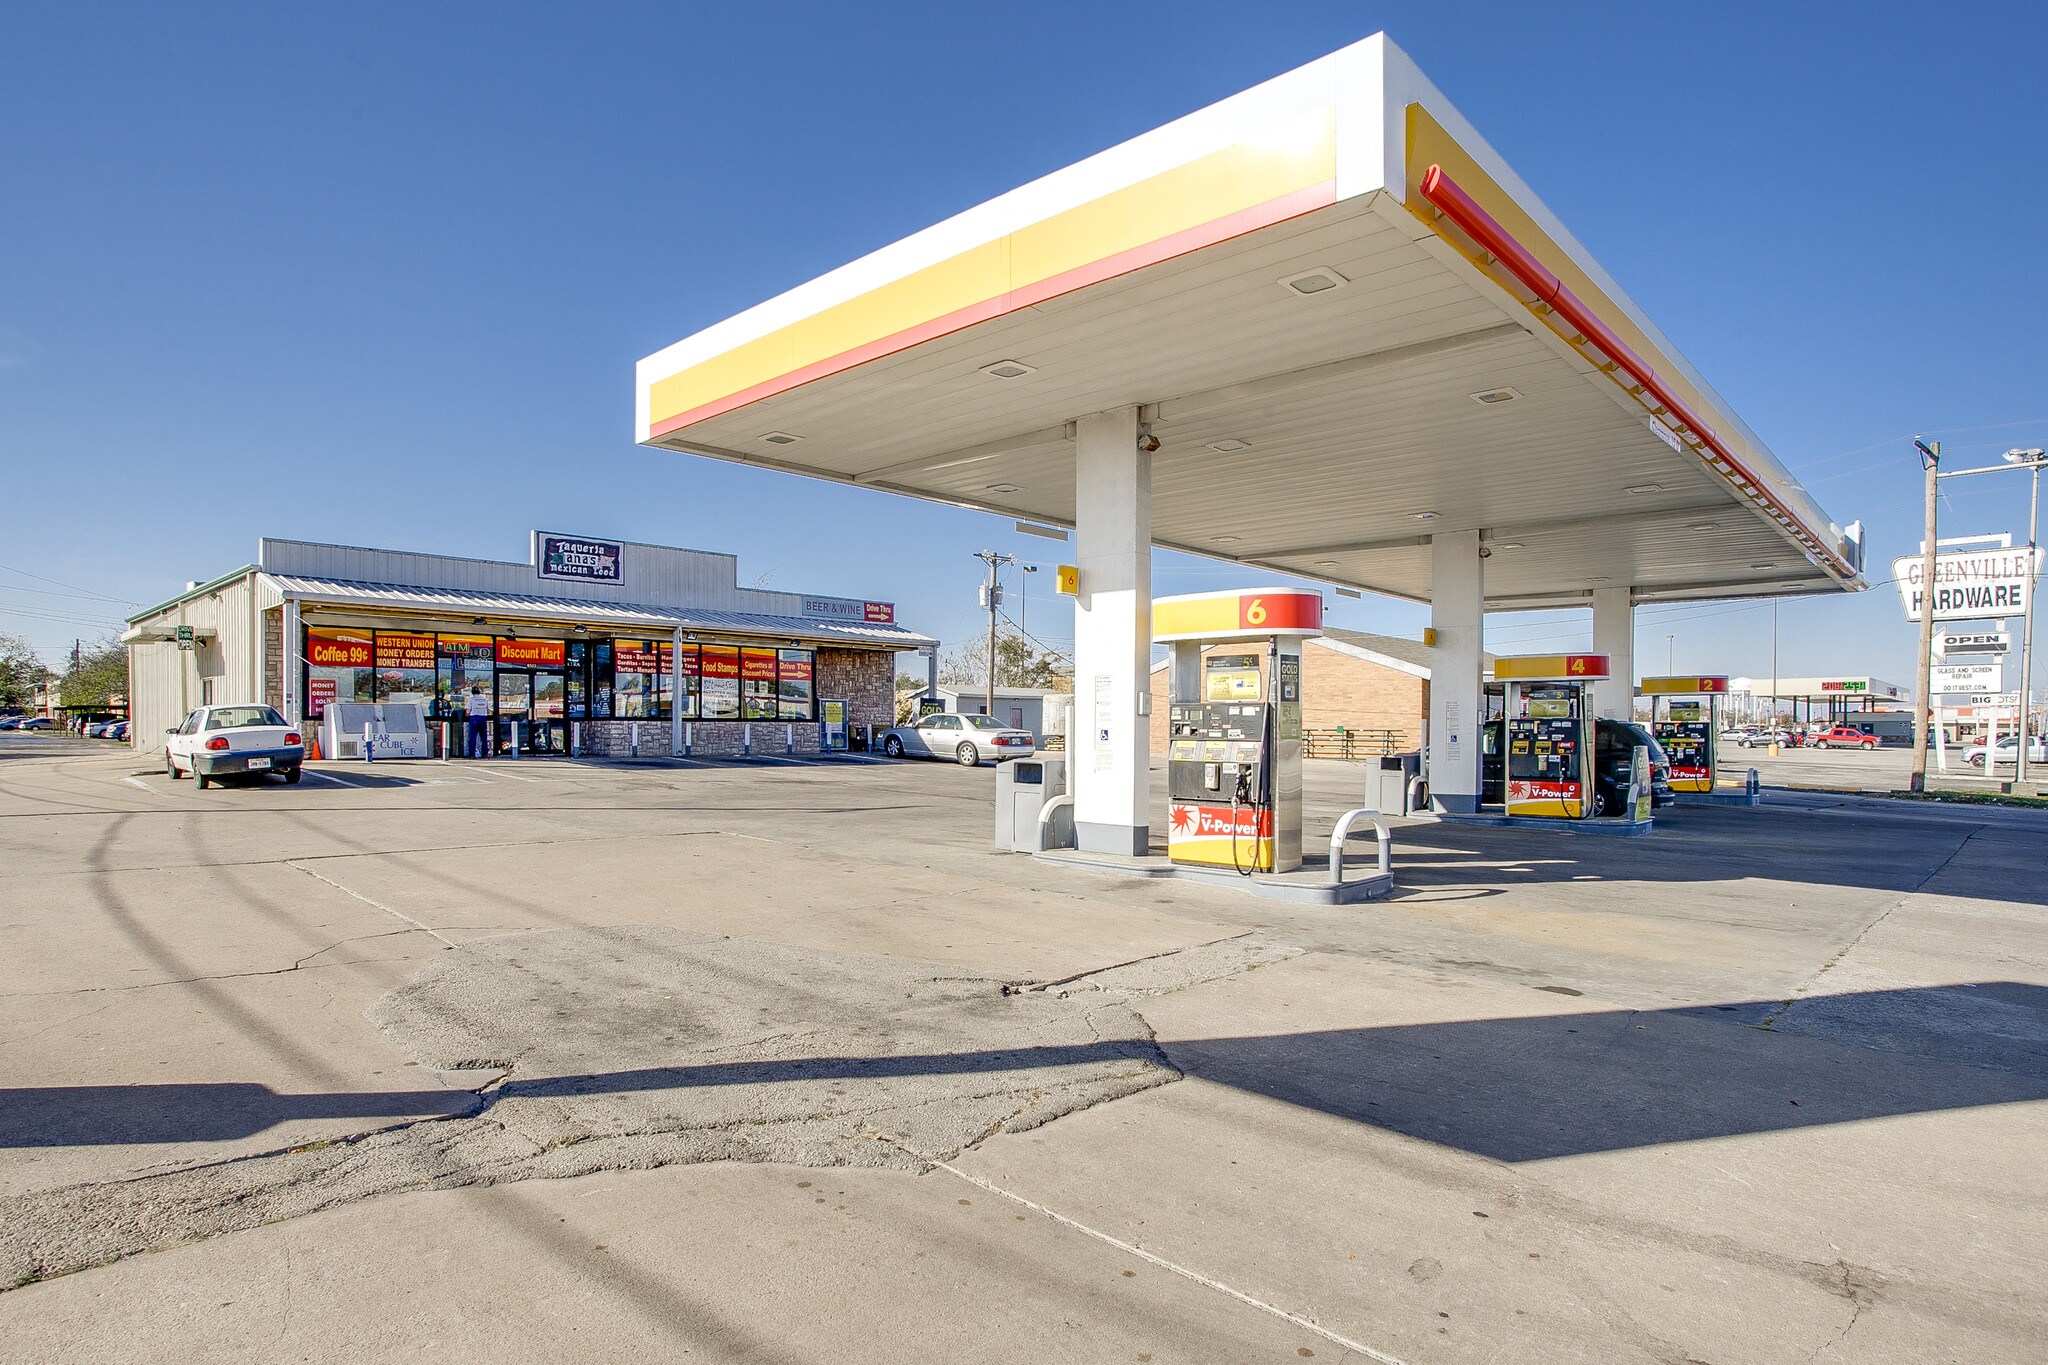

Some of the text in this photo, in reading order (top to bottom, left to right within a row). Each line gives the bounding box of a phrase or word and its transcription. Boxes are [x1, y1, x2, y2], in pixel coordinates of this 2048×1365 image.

[1068, 575, 1074, 585] 6
[806, 601, 861, 615] BEER & WINE
[866, 604, 891, 613] Drive Thru
[1246, 599, 1267, 625] 6
[376, 637, 410, 647] WESTERN
[412, 639, 435, 648] UNION
[1944, 635, 1999, 644] OPEN
[446, 642, 468, 652] ATM
[314, 645, 368, 662] Coffee 99¢
[376, 648, 435, 658] MONEY ORDERS
[501, 645, 539, 659] Discount
[541, 647, 561, 660] Mart
[376, 658, 435, 668] MONEY TRANSFER
[702, 661, 739, 675] Food Stamps
[745, 661, 767, 670] Cigarettes
[780, 662, 811, 671] Drive Thru
[1571, 658, 1585, 674] 4
[742, 669, 775, 678] Discount Prices
[1281, 664, 1298, 674] GOLD
[1703, 680, 1713, 690] 2
[921, 706, 942, 715] GOLD
[380, 741, 404, 749] CUBE
[400, 748, 415, 756] ICE
[1672, 771, 1704, 779] V-Power
[1532, 788, 1572, 798] V-Power
[1201, 818, 1257, 835] V-Power
